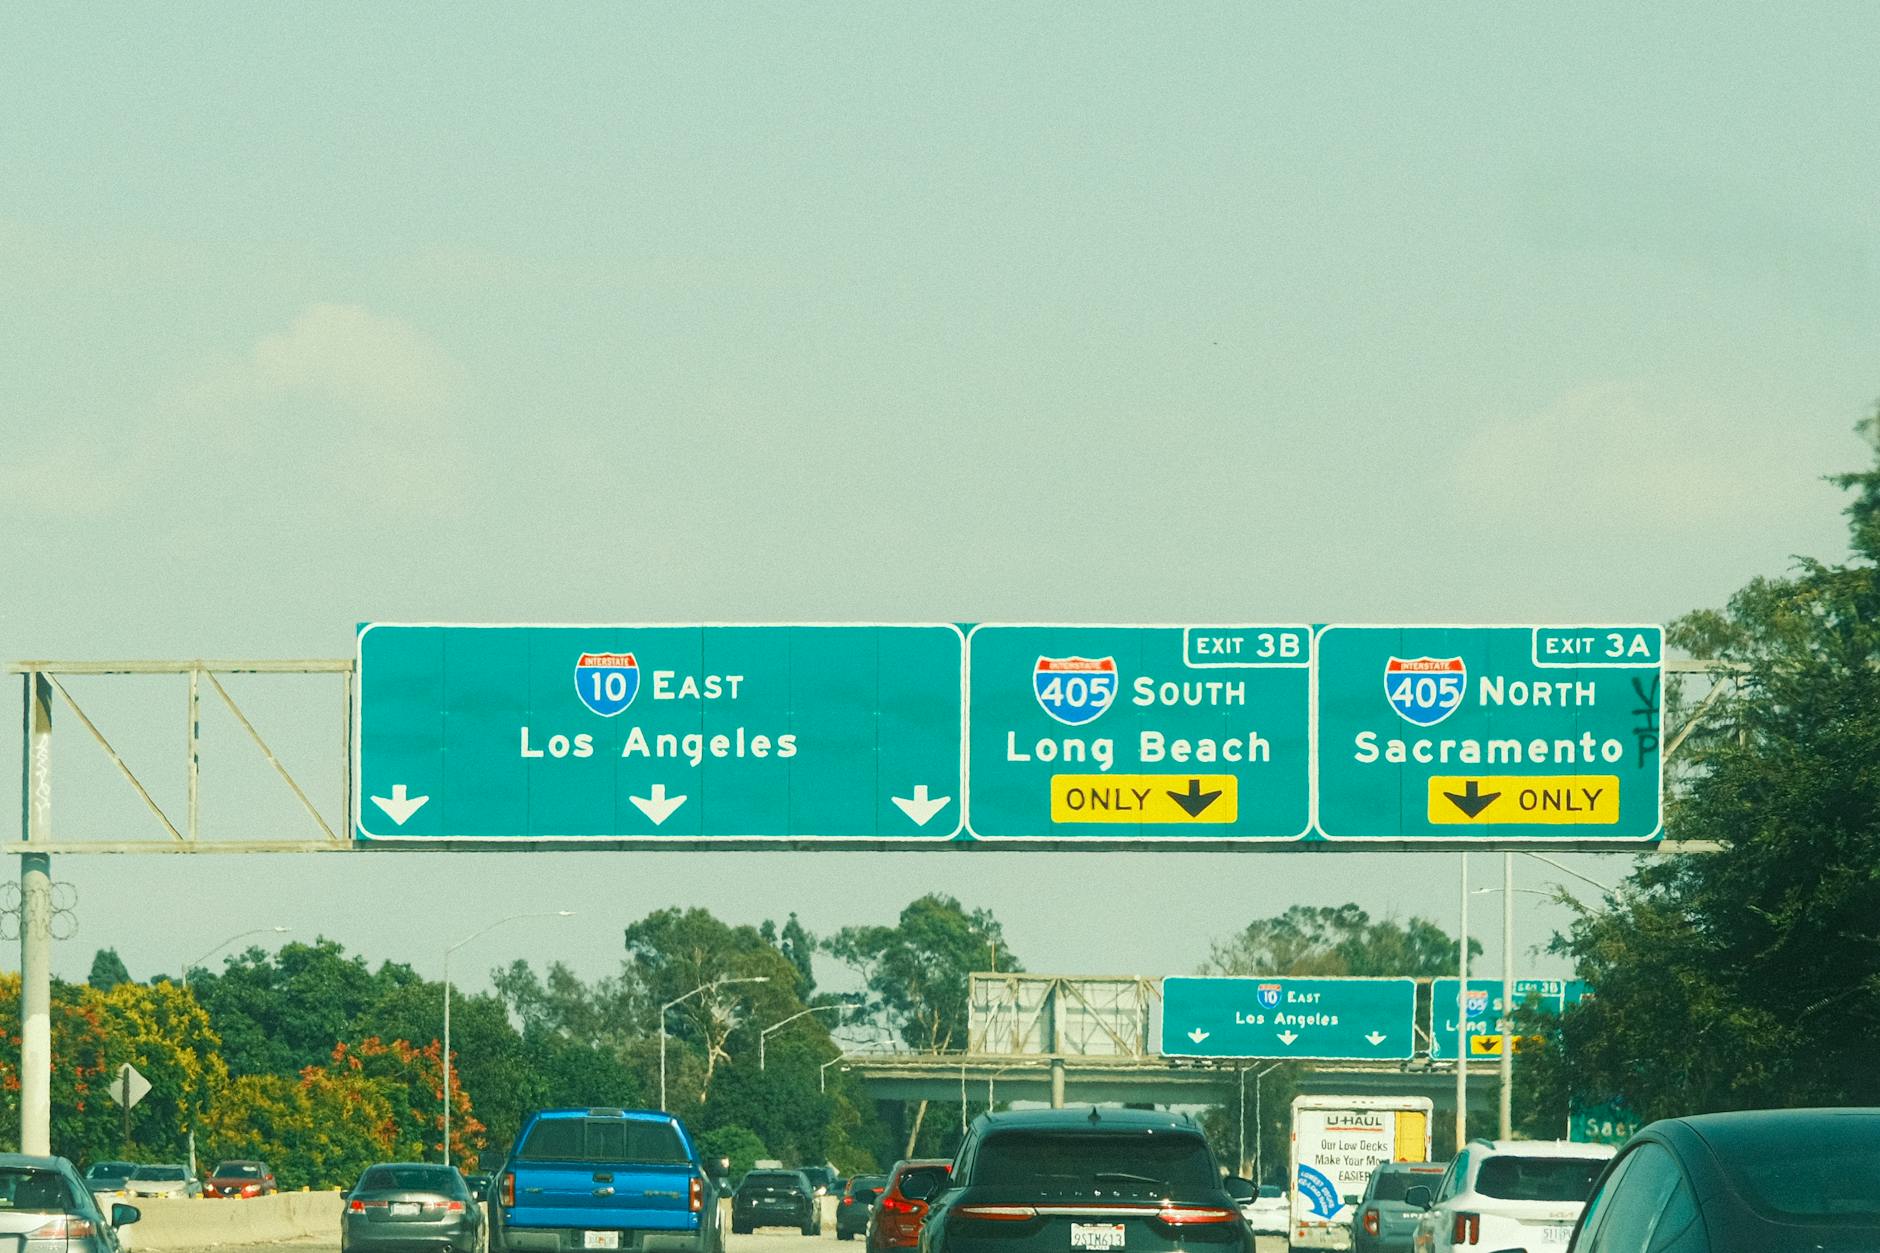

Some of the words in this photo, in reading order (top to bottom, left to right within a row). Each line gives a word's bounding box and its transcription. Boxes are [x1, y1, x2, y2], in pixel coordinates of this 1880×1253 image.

[1196, 636, 1243, 655] EXIT
[1256, 633, 1300, 659] 3B
[1546, 636, 1594, 655] EXIT
[1605, 633, 1650, 659] 3A
[584, 656, 630, 666] INTERSTATE
[1400, 661, 1450, 671] INTERSTATE
[591, 672, 627, 702] 10
[653, 670, 744, 700] EAST
[1040, 677, 1113, 708] 405
[1132, 676, 1245, 707] SOUTH
[1391, 677, 1461, 709] 405
[1479, 675, 1596, 707] NORTH
[520, 726, 594, 759] Los
[622, 726, 797, 767] Angeles
[1007, 730, 1115, 771] Long
[1140, 730, 1270, 763] Beach
[1354, 731, 1623, 764] Sacramento
[1066, 788, 1150, 811] ONLY
[1519, 788, 1603, 811] ONLY
[1264, 990, 1278, 1004] 10
[1287, 991, 1321, 1003] EAST
[1235, 1011, 1265, 1025] Los
[1274, 1012, 1339, 1029] Angeles
[1445, 1019, 1487, 1035] Lng
[1327, 1116, 1383, 1126] U-HAUL
[1321, 1140, 1336, 1151] Our
[1338, 1140, 1357, 1151] Low
[1359, 1140, 1388, 1152] Decks
[1315, 1154, 1341, 1166] Make
[1343, 1155, 1363, 1167] Your
